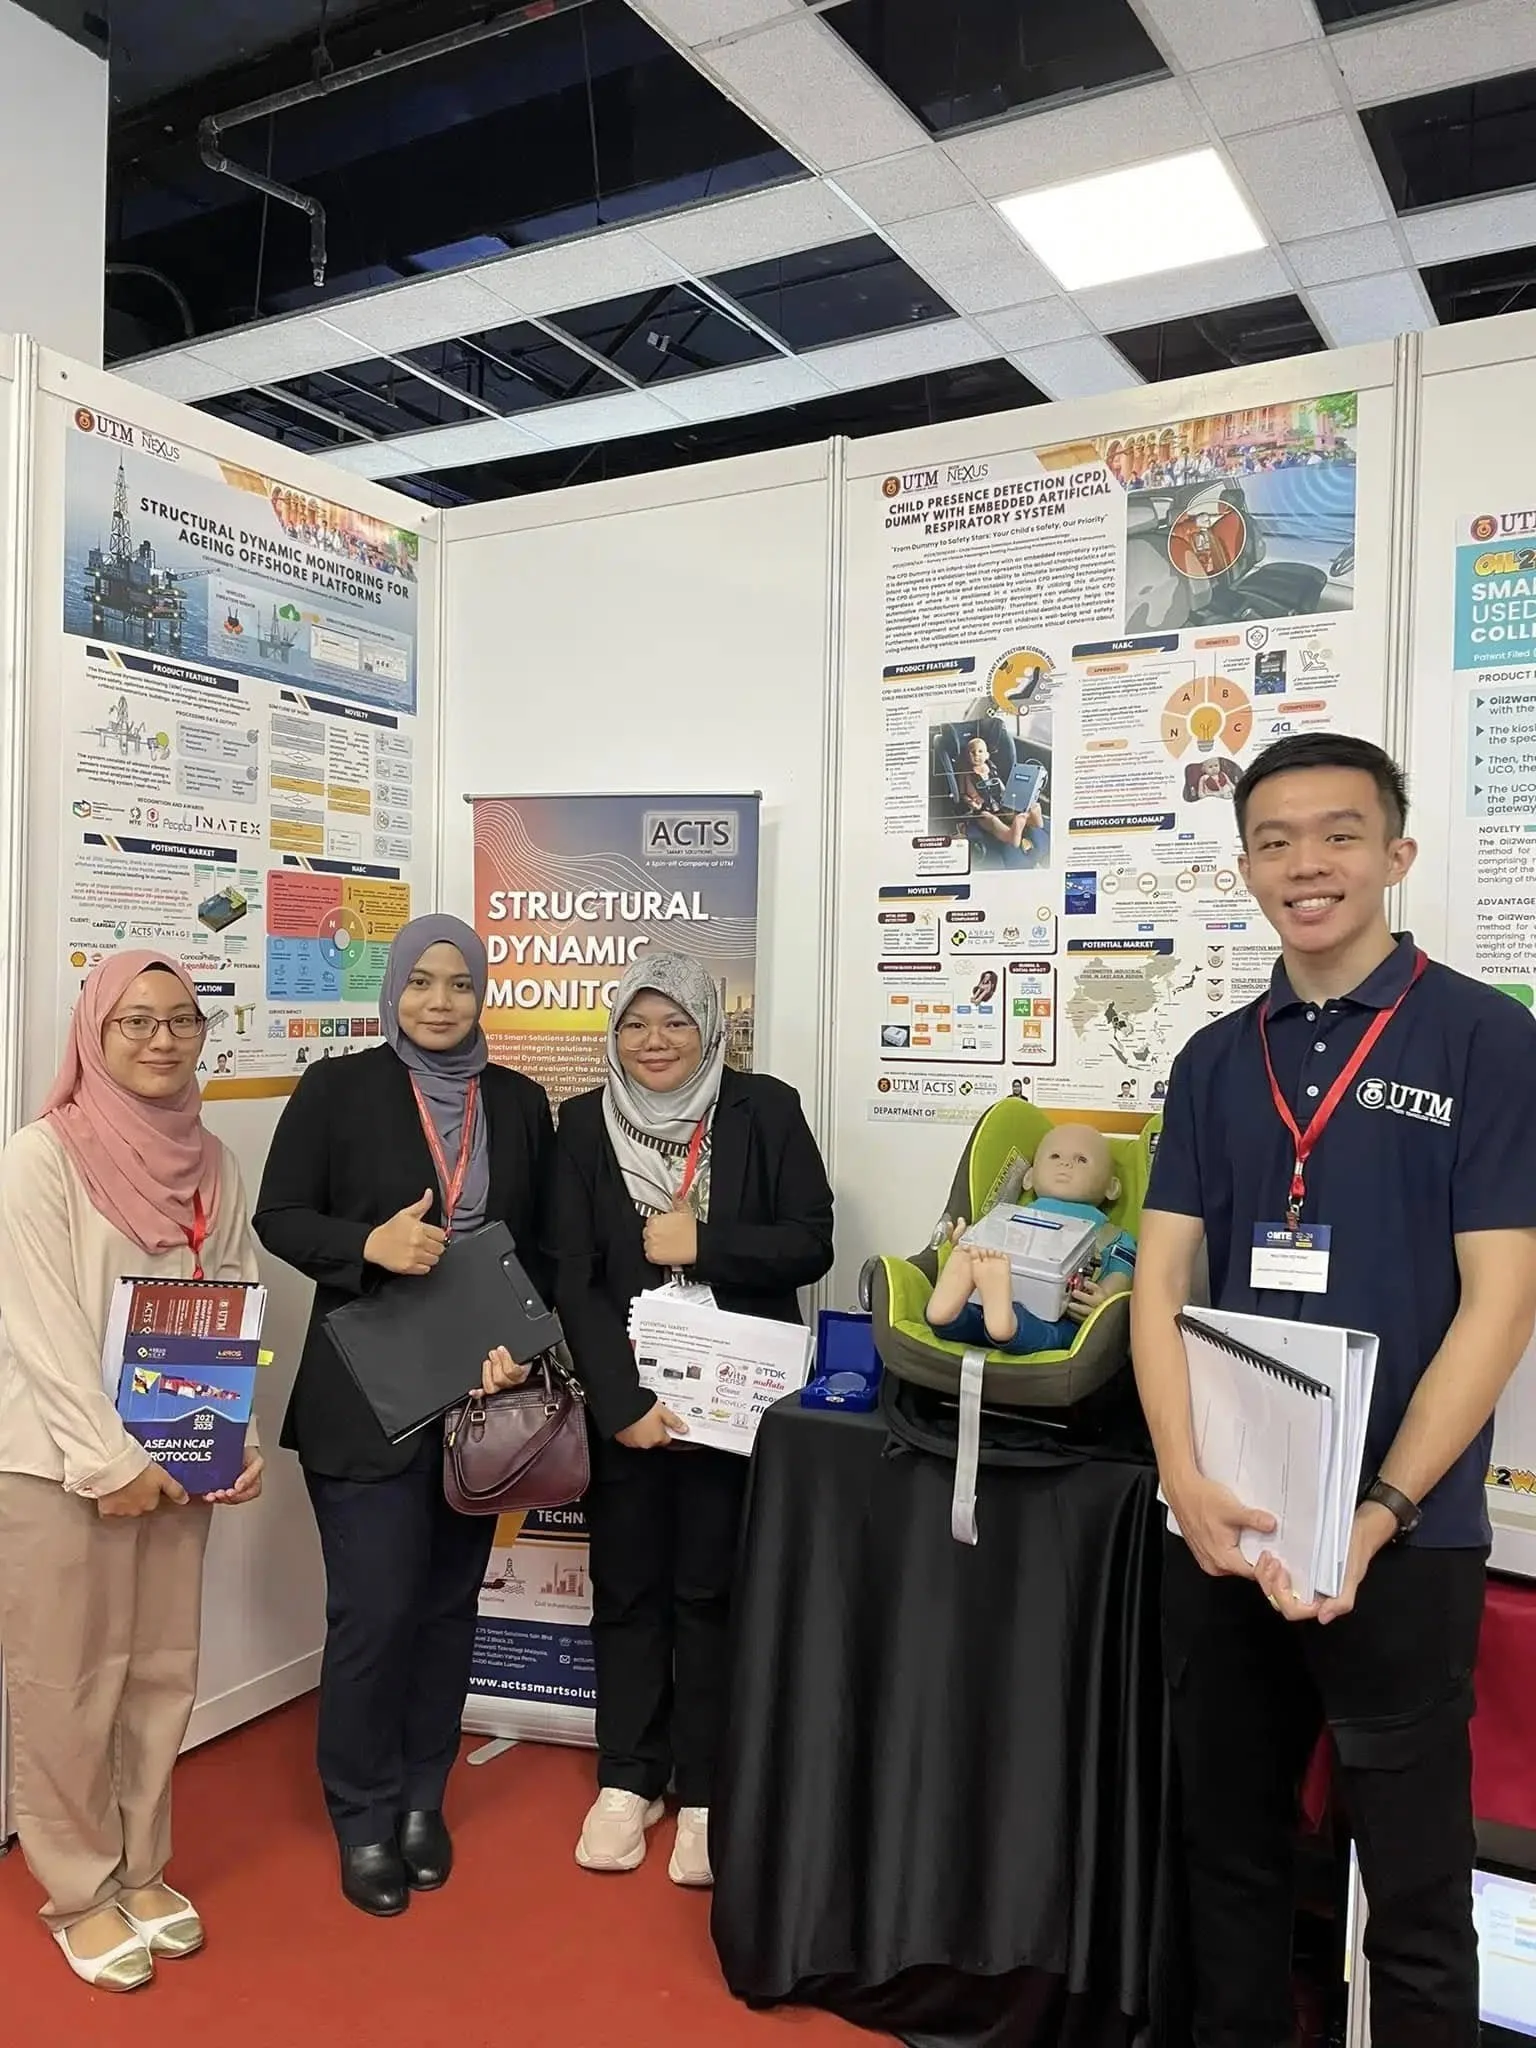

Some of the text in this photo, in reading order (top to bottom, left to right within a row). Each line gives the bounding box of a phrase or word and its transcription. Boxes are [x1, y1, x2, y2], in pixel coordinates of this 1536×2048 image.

[96, 415, 134, 442] UTM
[142, 435, 180, 460] NEXUS
[947, 463, 989, 483] NEXUS
[902, 470, 939, 490] UTM
[889, 468, 1108, 516] CHILD PRESENCE DETECTION (CPD)
[885, 483, 1112, 529] DUMMY WITH EMBEDDED ARTIFICIAL
[925, 504, 1066, 535] RESPIRATORY SYSTEM
[1500, 511, 1536, 532] UT
[911, 541, 939, 553] Dummy
[940, 539, 947, 547] to
[948, 535, 970, 547] Safety
[971, 532, 992, 542] Stars:
[993, 529, 1009, 539] Your
[1010, 526, 1035, 537] Child's
[1036, 522, 1061, 534] Safety,
[1062, 518, 1076, 528] Our
[140, 498, 235, 540] STRUCTURAL
[240, 532, 301, 562] DYNAMIC
[306, 554, 385, 590] MONITORING
[388, 580, 409, 599] FOR
[179, 529, 235, 557] AGEING
[239, 548, 308, 580] OFFSHORE
[312, 571, 382, 604] PLATFORMS
[1474, 549, 1536, 576] OIL2
[909, 592, 929, 600] dummy
[1052, 573, 1074, 581] sensing
[1076, 567, 1115, 578] technologies
[1471, 578, 1536, 601] SMA
[1472, 600, 1536, 624] USED
[1470, 622, 1536, 643] COLL
[1112, 640, 1133, 650] NABC
[1473, 652, 1506, 662] Patent
[895, 661, 959, 674] PRODUCT FEATURES
[152, 663, 217, 685] PRODUCT FEATURES
[1478, 670, 1531, 683] PRODUCT
[1182, 693, 1191, 702] A
[1222, 689, 1229, 698] B
[1489, 695, 1536, 706] Oil2Wan
[345, 708, 368, 719] NOVELTY
[1489, 703, 1535, 716] with the
[1170, 728, 1178, 737] N
[1234, 722, 1242, 732] C
[1489, 725, 1510, 735] The
[1488, 735, 1507, 745] the
[1489, 755, 1519, 766] Then,
[1488, 763, 1536, 775] UCO, the
[1487, 783, 1536, 794] The UCO
[137, 797, 170, 807] RECOGNITION
[1487, 794, 1536, 805] the pay
[1486, 804, 1536, 817] gateway
[195, 815, 261, 835] INATEX
[1075, 815, 1164, 827] TECHNOLOGY ROADMAP
[651, 821, 729, 846] ACTS
[1478, 825, 1521, 834] NOVELTY
[1499, 838, 1536, 846] Oil2Wan
[151, 843, 216, 857] POTENTIAL MARKET
[1478, 846, 1530, 855] method for
[678, 860, 710, 868] Company
[1478, 855, 1528, 866] comprising
[1477, 864, 1535, 876] weight of the
[1477, 874, 1524, 885] banking of
[908, 887, 937, 895] NOVELTY
[487, 890, 709, 921] STRUCTURAL
[1476, 897, 1536, 906] ADVANTAGE
[1497, 913, 1536, 921] Oil2Wan
[130, 927, 152, 937] ACTS
[1476, 922, 1528, 931] method for
[1476, 932, 1526, 943] comprising
[487, 934, 650, 965] DYNAMIC
[1083, 940, 1154, 949] POTENTIAL MARKET
[1476, 941, 1532, 952] weight of the
[180, 952, 221, 961] ConocoPhillips
[1475, 951, 1536, 961] banking of the
[1480, 966, 1531, 974] POTENTIAL
[195, 984, 223, 993] ICATION
[486, 978, 621, 1009] MONITO
[486, 1033, 502, 1041] ACTS
[529, 1034, 564, 1042] Solutions
[565, 1034, 580, 1042] Sdn
[582, 1034, 597, 1042] Bhd
[522, 1045, 554, 1053] integrity
[521, 1055, 555, 1063] Dynamic
[557, 1056, 601, 1064] Monitoring
[893, 1079, 919, 1091] UTM
[924, 1083, 954, 1093] ACTS
[1390, 1081, 1454, 1122] UTM
[873, 1106, 923, 1116] DEPARTMENT
[925, 1109, 936, 1117] OF
[763, 1367, 786, 1380] TDK
[752, 1392, 775, 1403] Azco
[193, 1414, 214, 1423] 2021
[193, 1422, 214, 1431] 2025
[143, 1439, 215, 1449] ASEAN NCAP
[150, 1451, 212, 1462] ROTOCOLS
[537, 1510, 585, 1524] TECHN
[469, 1676, 597, 1699] www.actssmartsolut
